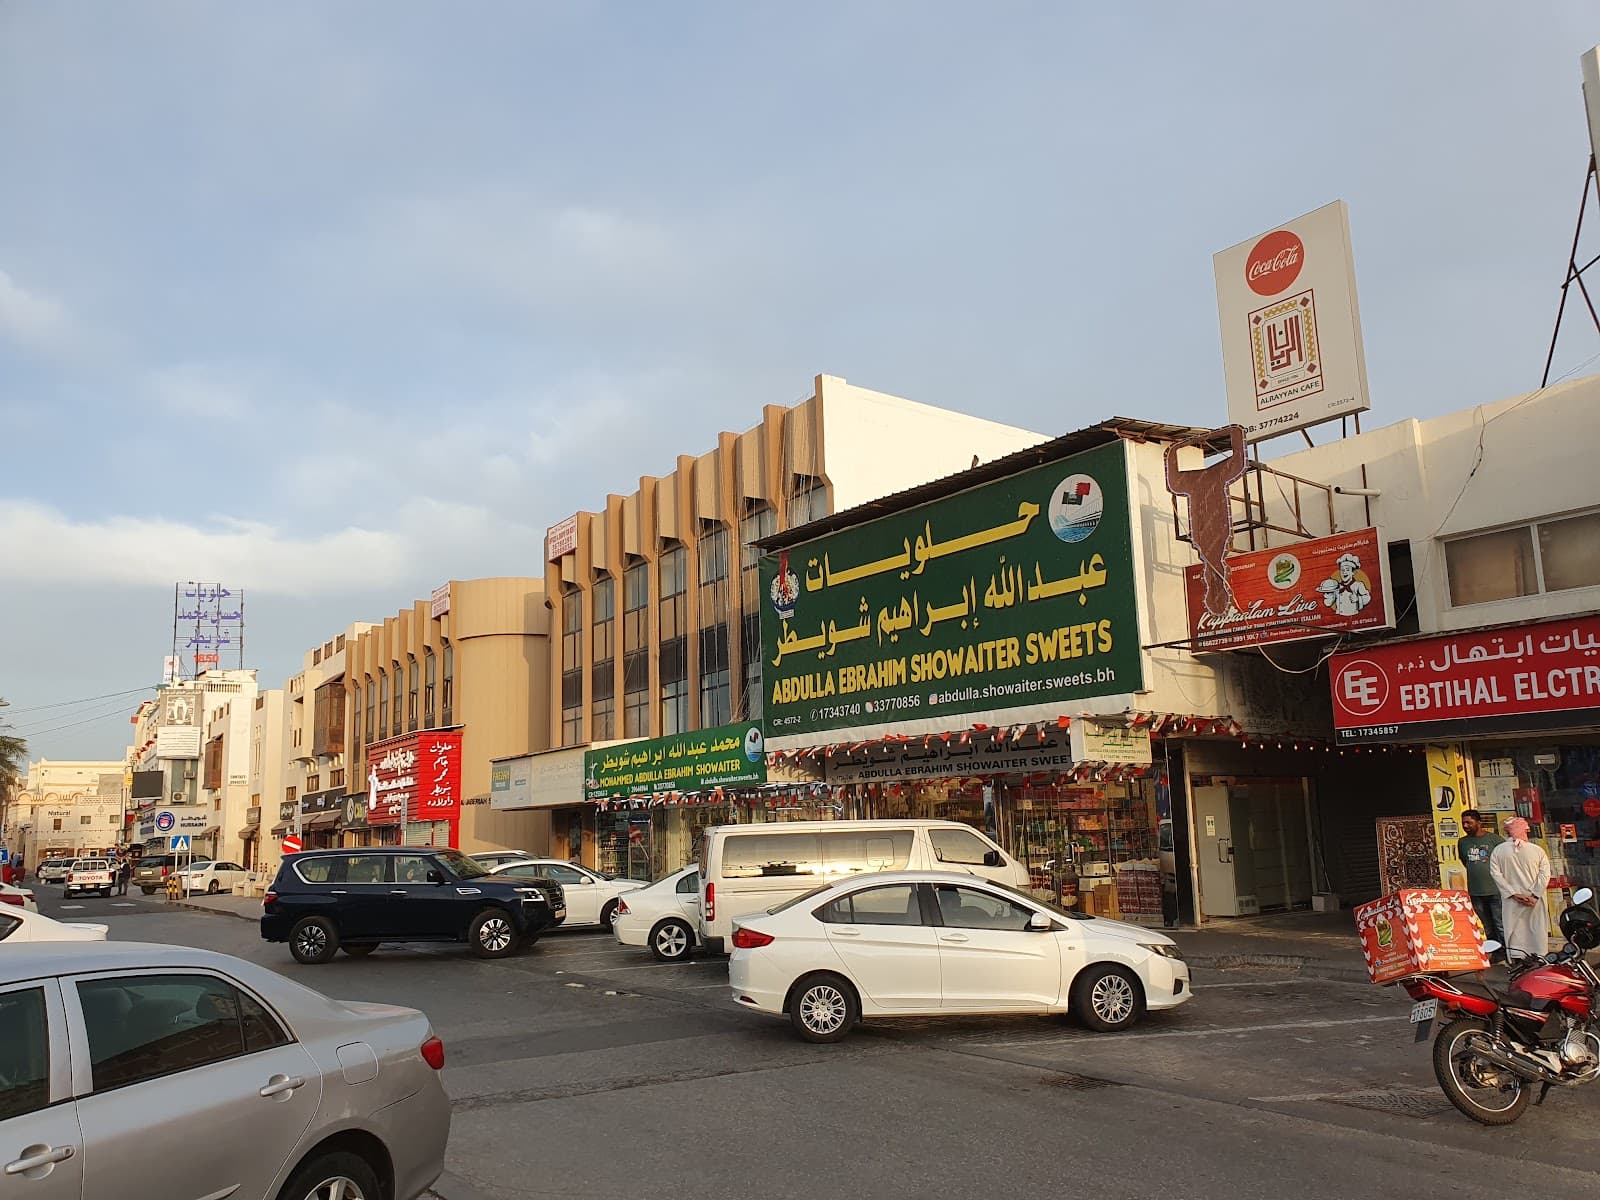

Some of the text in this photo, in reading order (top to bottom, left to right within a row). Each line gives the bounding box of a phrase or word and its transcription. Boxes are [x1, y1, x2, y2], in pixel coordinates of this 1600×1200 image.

[1249, 243, 1300, 281] Coca-Cola
[1300, 380, 1320, 392] CAFE
[1259, 412, 1299, 430] 37774224
[177, 607, 208, 620] محمد
[877, 576, 977, 648] إبراهيم
[1278, 594, 1318, 616] Live
[772, 595, 871, 667] شويطر
[772, 618, 1113, 705] ABDULLA EBRAHIM SHOWAITER SWEETS
[1430, 633, 1534, 672] ابتهال
[819, 703, 861, 720] 17343740
[873, 695, 921, 712] 33770856
[938, 668, 1115, 704] abdulla.showaiter.sweets.bh
[1399, 665, 1600, 712] EBTIHAL ELCTR
[710, 736, 741, 753] محمد
[1341, 729, 1357, 738] TEL:
[600, 759, 741, 788] MOHAMMED ABDULLA EBRAHIM SHOWAITER
[601, 750, 630, 774] شويطر
[858, 768, 903, 779] ABDULLA
[905, 763, 953, 775] EBRAHIM
[956, 758, 1028, 771] SHOWAITER
[1031, 754, 1071, 766] SWEE
[79, 874, 103, 882] TOYOTA
